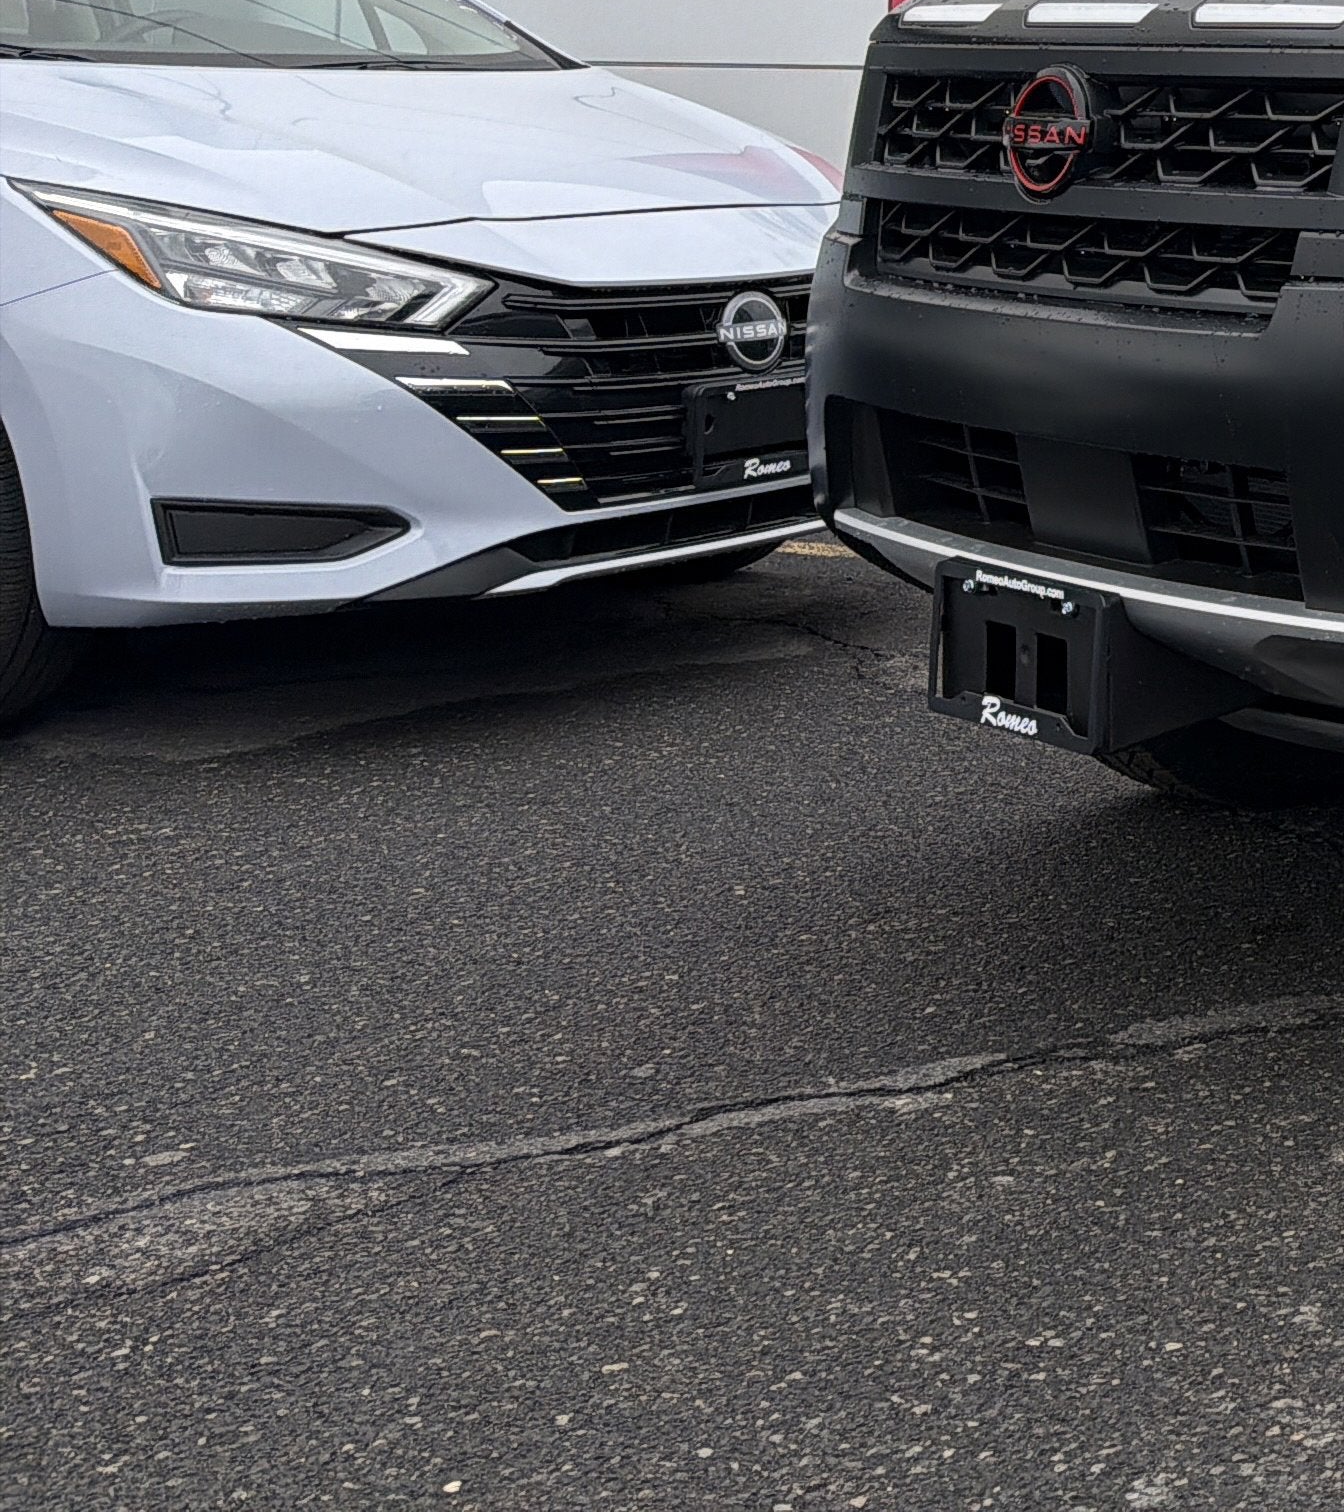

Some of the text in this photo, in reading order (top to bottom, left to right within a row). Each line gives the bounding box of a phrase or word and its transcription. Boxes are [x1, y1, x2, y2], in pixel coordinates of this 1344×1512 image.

[719, 321, 787, 341] NISSAN
[743, 458, 791, 480] Romeo
[975, 569, 1065, 600] RomeoAutoGroup.com
[980, 695, 1038, 735] Romeo
